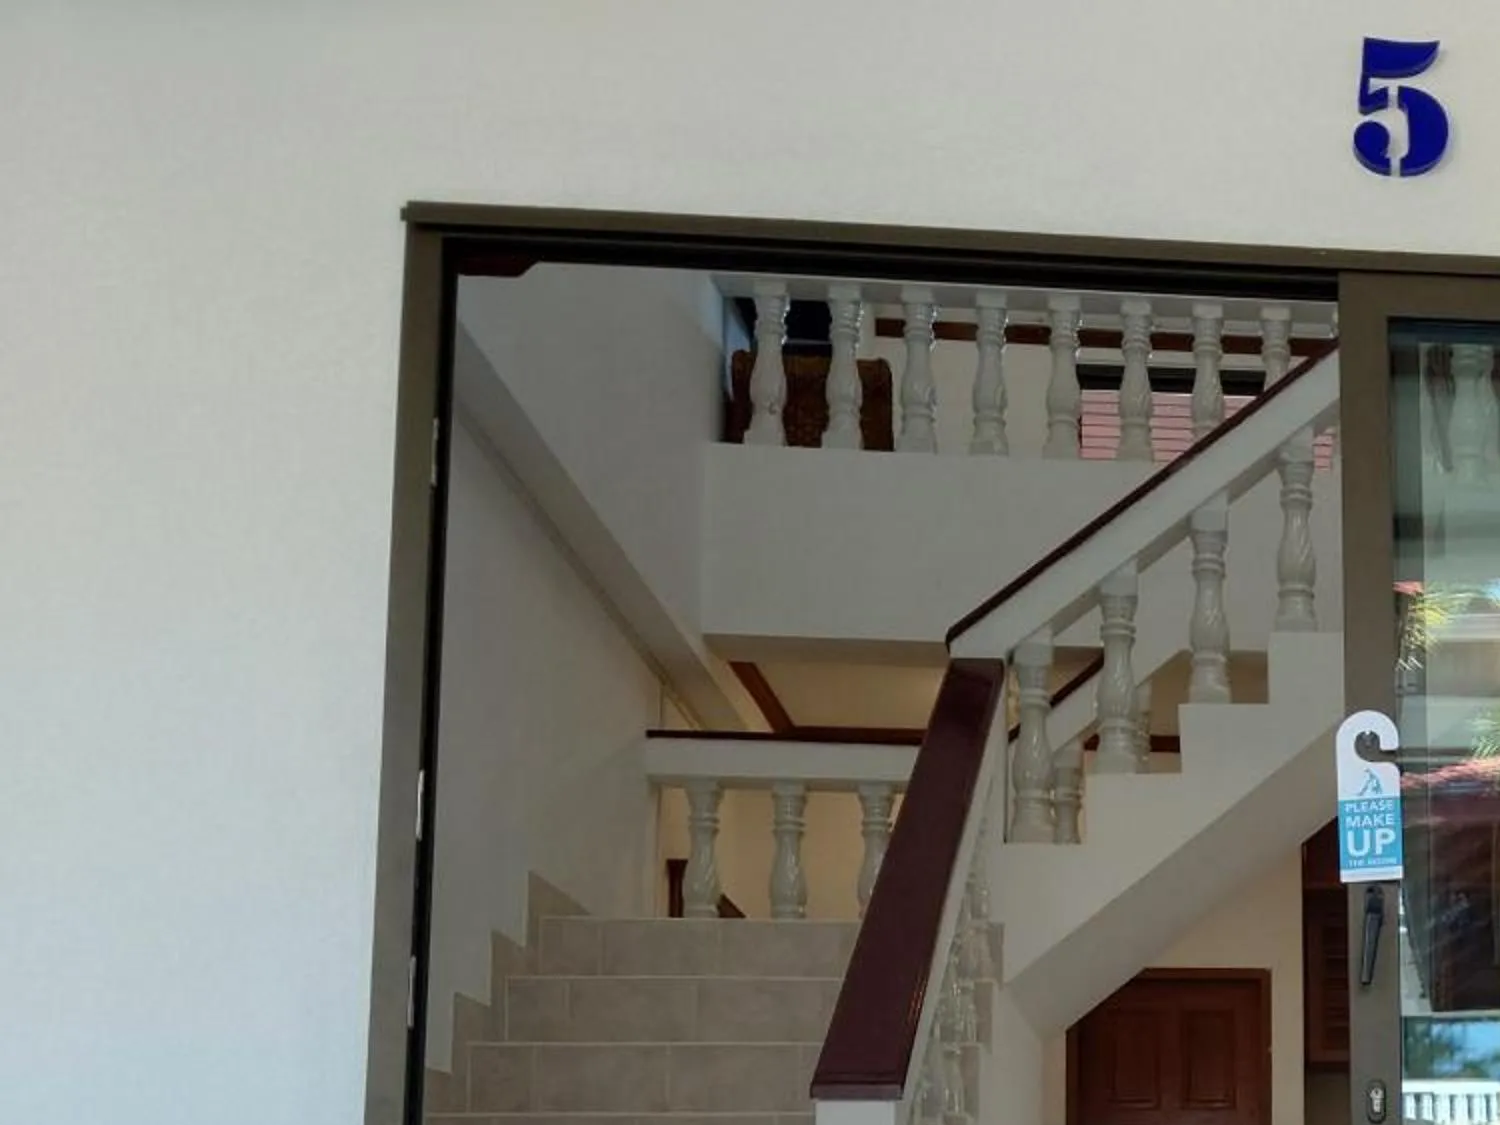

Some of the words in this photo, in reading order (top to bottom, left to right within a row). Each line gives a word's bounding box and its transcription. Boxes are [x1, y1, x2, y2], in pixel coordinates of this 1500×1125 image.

[1354, 37, 1449, 177] 5
[1344, 800, 1393, 813] PLEASE
[1345, 813, 1395, 828] MAKE
[1347, 828, 1396, 857] UP
